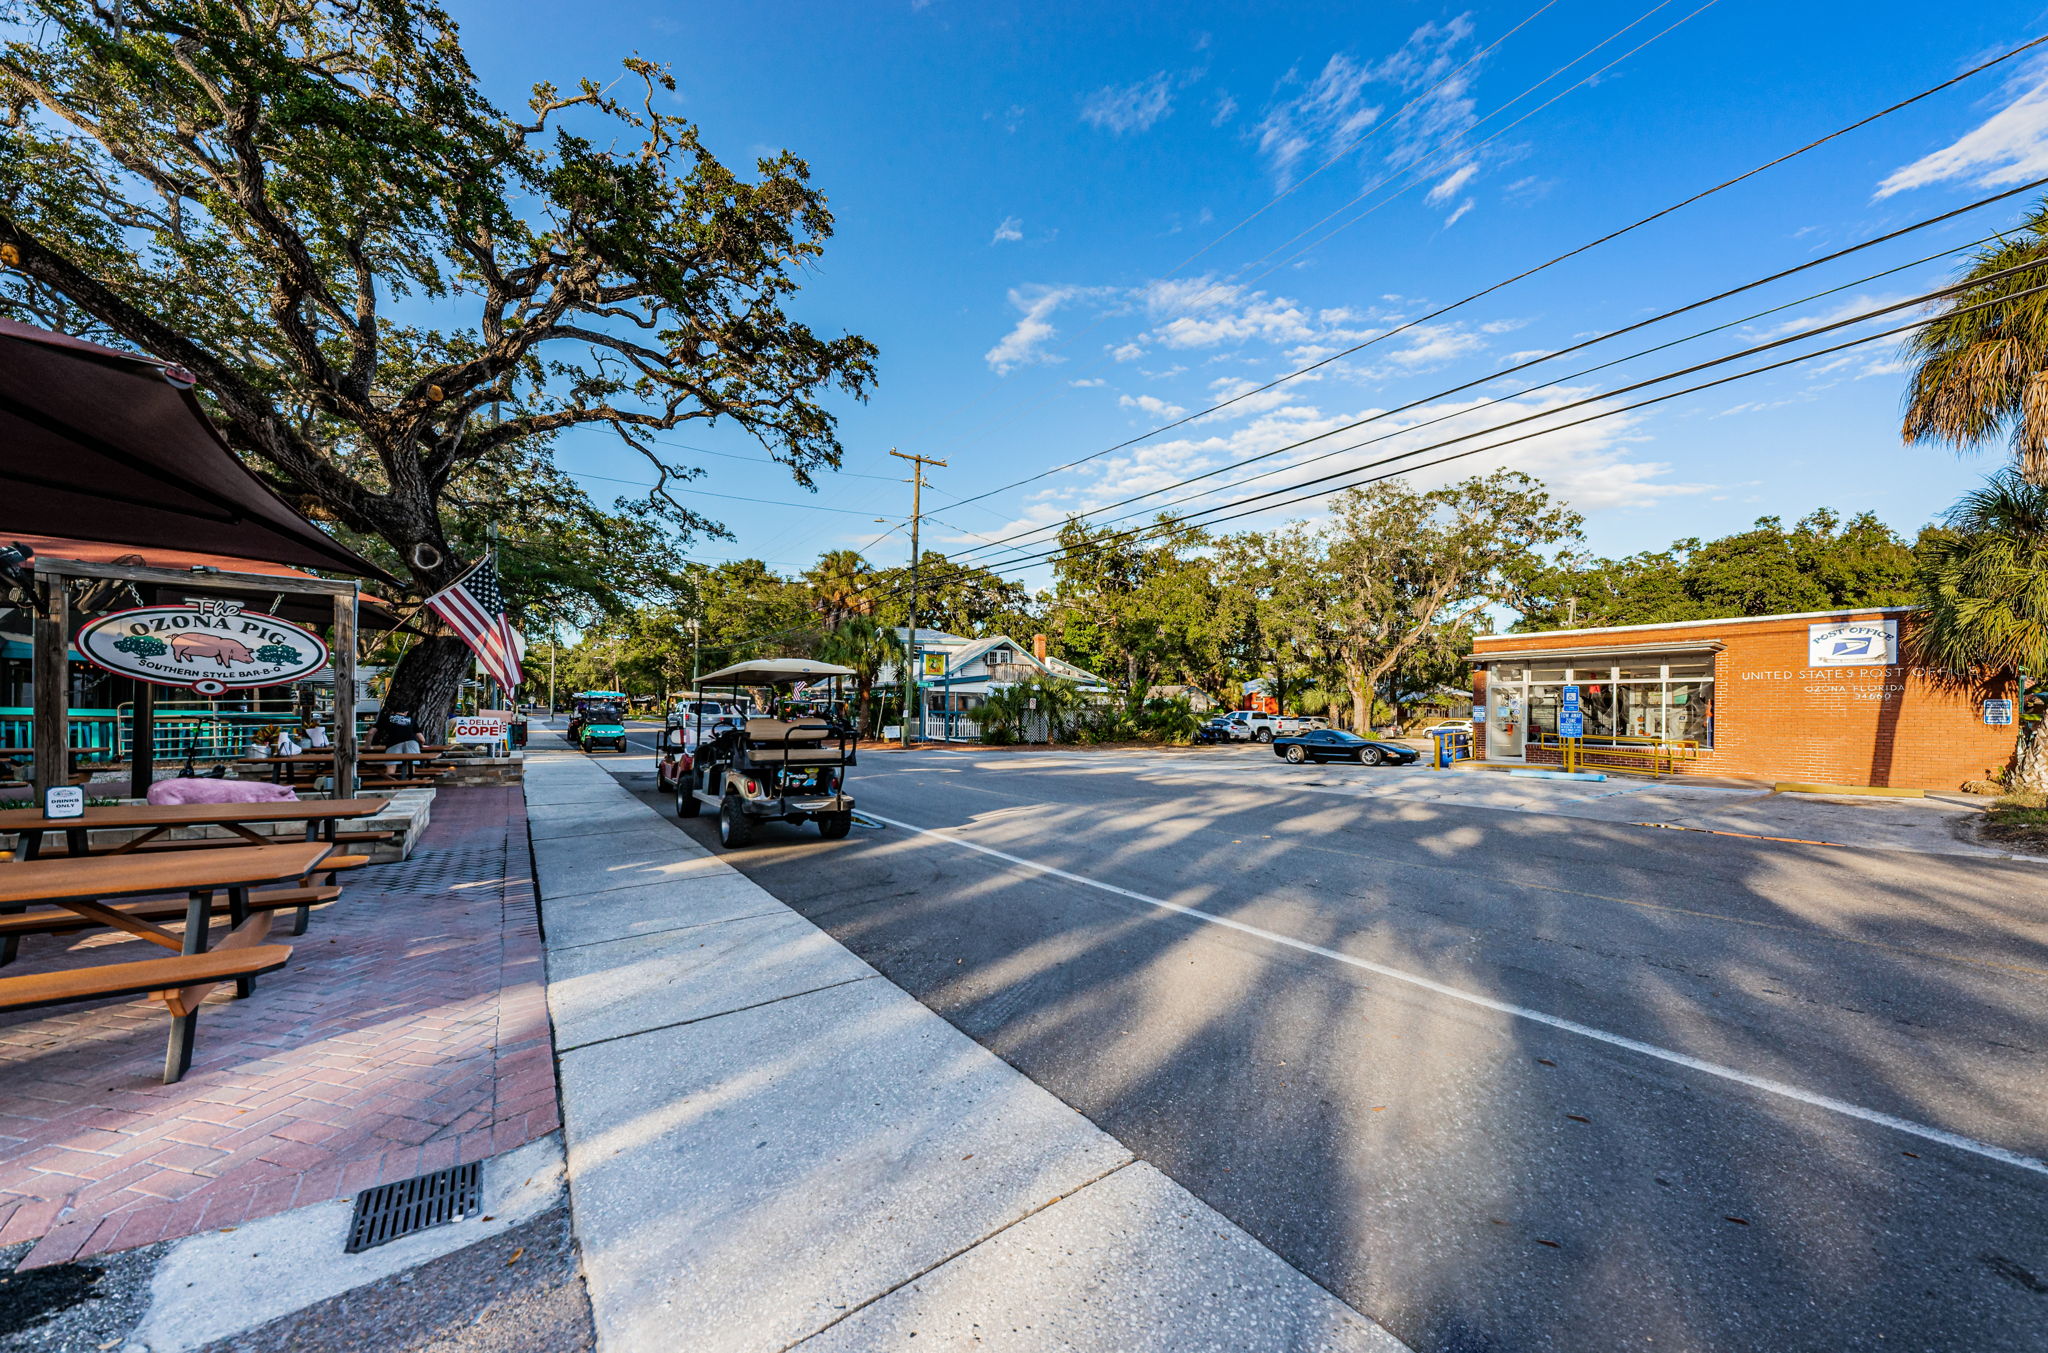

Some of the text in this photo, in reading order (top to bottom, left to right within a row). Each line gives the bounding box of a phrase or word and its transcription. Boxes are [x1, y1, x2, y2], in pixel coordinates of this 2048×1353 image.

[184, 599, 241, 617] The
[129, 615, 288, 646] OZONA PIG
[1812, 626, 1895, 645] POST OFFICE
[138, 659, 199, 677] SOUTHERN
[239, 666, 281, 678] BAR-B-Q
[1742, 670, 1793, 681] UNITED
[1799, 668, 1854, 680] STATES
[1860, 667, 1904, 678] POST
[1804, 684, 1905, 693] OZONA FLORIDA
[1854, 692, 1892, 700] 34660
[457, 725, 499, 736] COPE
